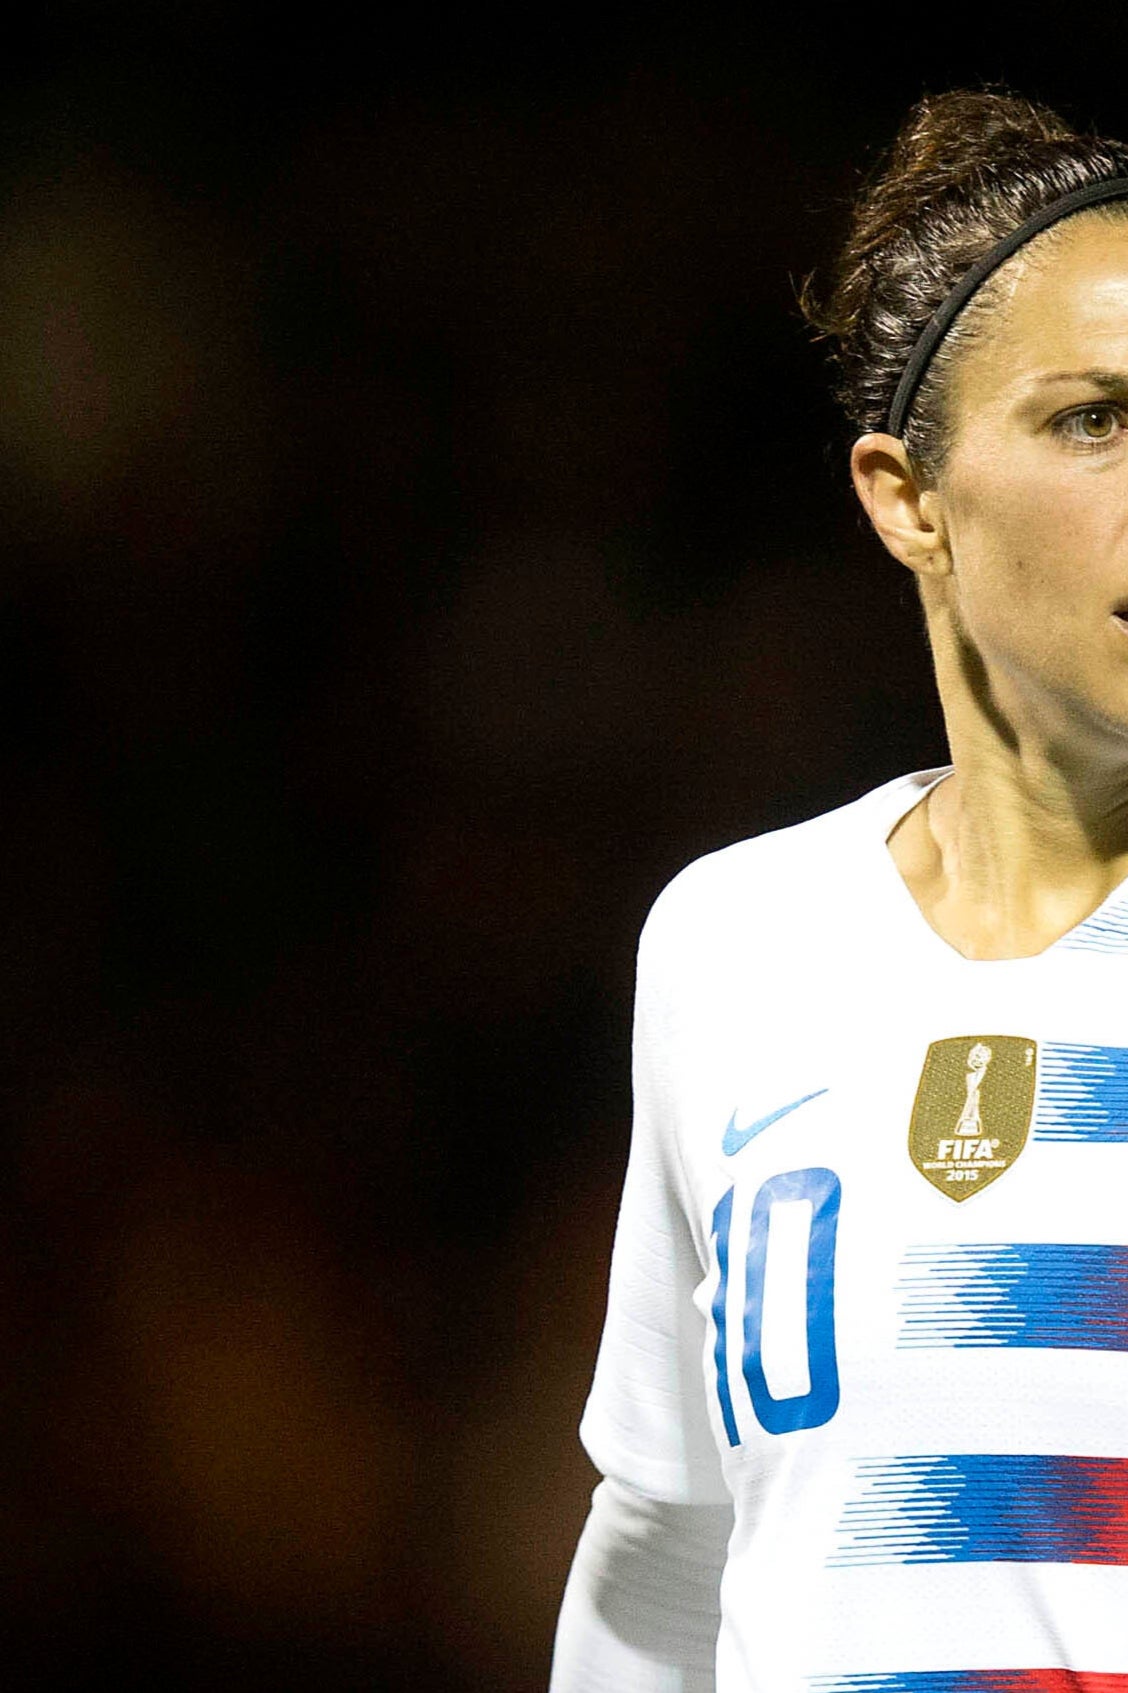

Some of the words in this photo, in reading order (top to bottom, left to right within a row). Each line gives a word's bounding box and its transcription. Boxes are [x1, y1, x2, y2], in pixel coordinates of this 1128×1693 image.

[937, 1139, 994, 1160] FIFA
[945, 1169, 979, 1182] 2015
[711, 1167, 842, 1447] 10
